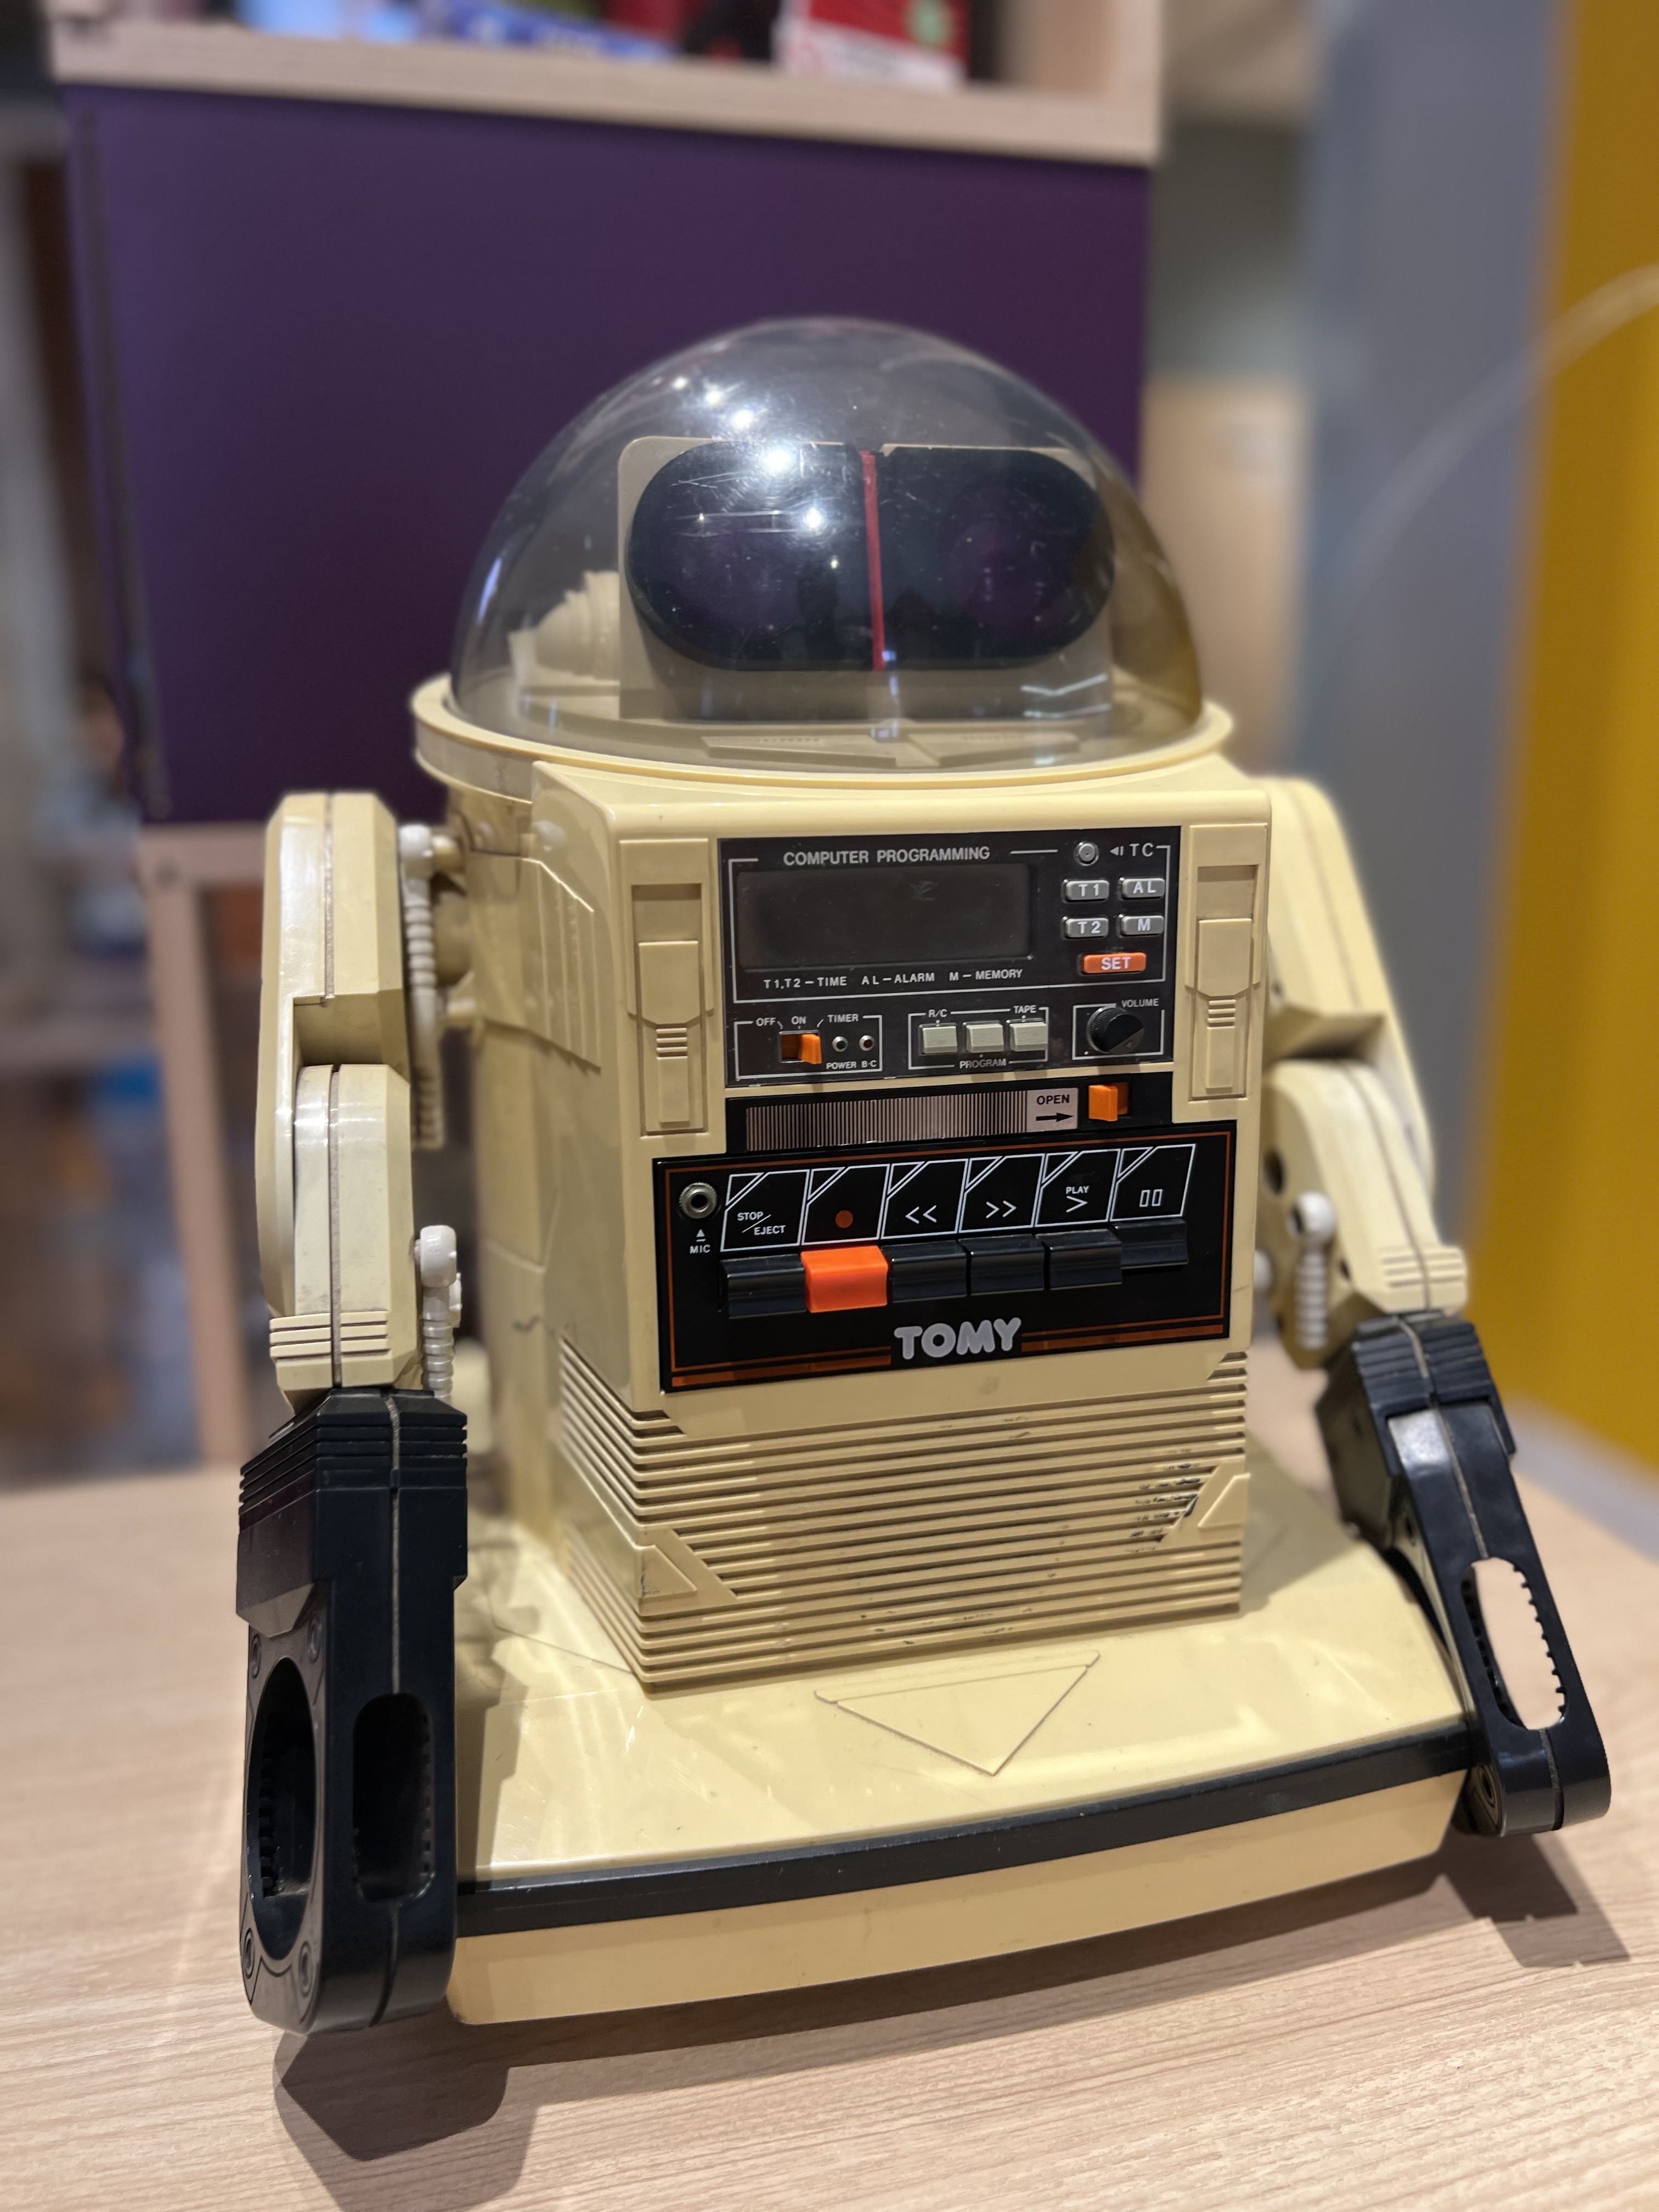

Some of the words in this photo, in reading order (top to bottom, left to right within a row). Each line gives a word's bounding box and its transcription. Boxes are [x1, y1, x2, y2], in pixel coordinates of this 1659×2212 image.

[1129, 843, 1153, 857] TC
[783, 851, 868, 866] COMPUTER
[877, 847, 990, 863] PROGRAMMING
[1079, 884, 1100, 896] T1
[1133, 881, 1156, 894] AL
[1077, 921, 1101, 934] T2
[1137, 918, 1151, 932] M
[1101, 957, 1131, 970] SET
[1122, 998, 1159, 1008] VOLUME
[928, 1009, 947, 1018] R/C
[1014, 1005, 1036, 1014] TAPE
[756, 1018, 776, 1026] OFF
[792, 1015, 806, 1024] ON
[827, 1014, 859, 1023] TIMER
[826, 1061, 857, 1070] POWER
[960, 1058, 1007, 1069] PROGRAM
[1037, 1094, 1070, 1105] OPEN
[1065, 1186, 1089, 1194] PLAY
[737, 1211, 763, 1221] STOP
[754, 1225, 786, 1235] EJECT
[690, 1244, 710, 1254] MIC
[894, 1317, 1022, 1359] TOMY
